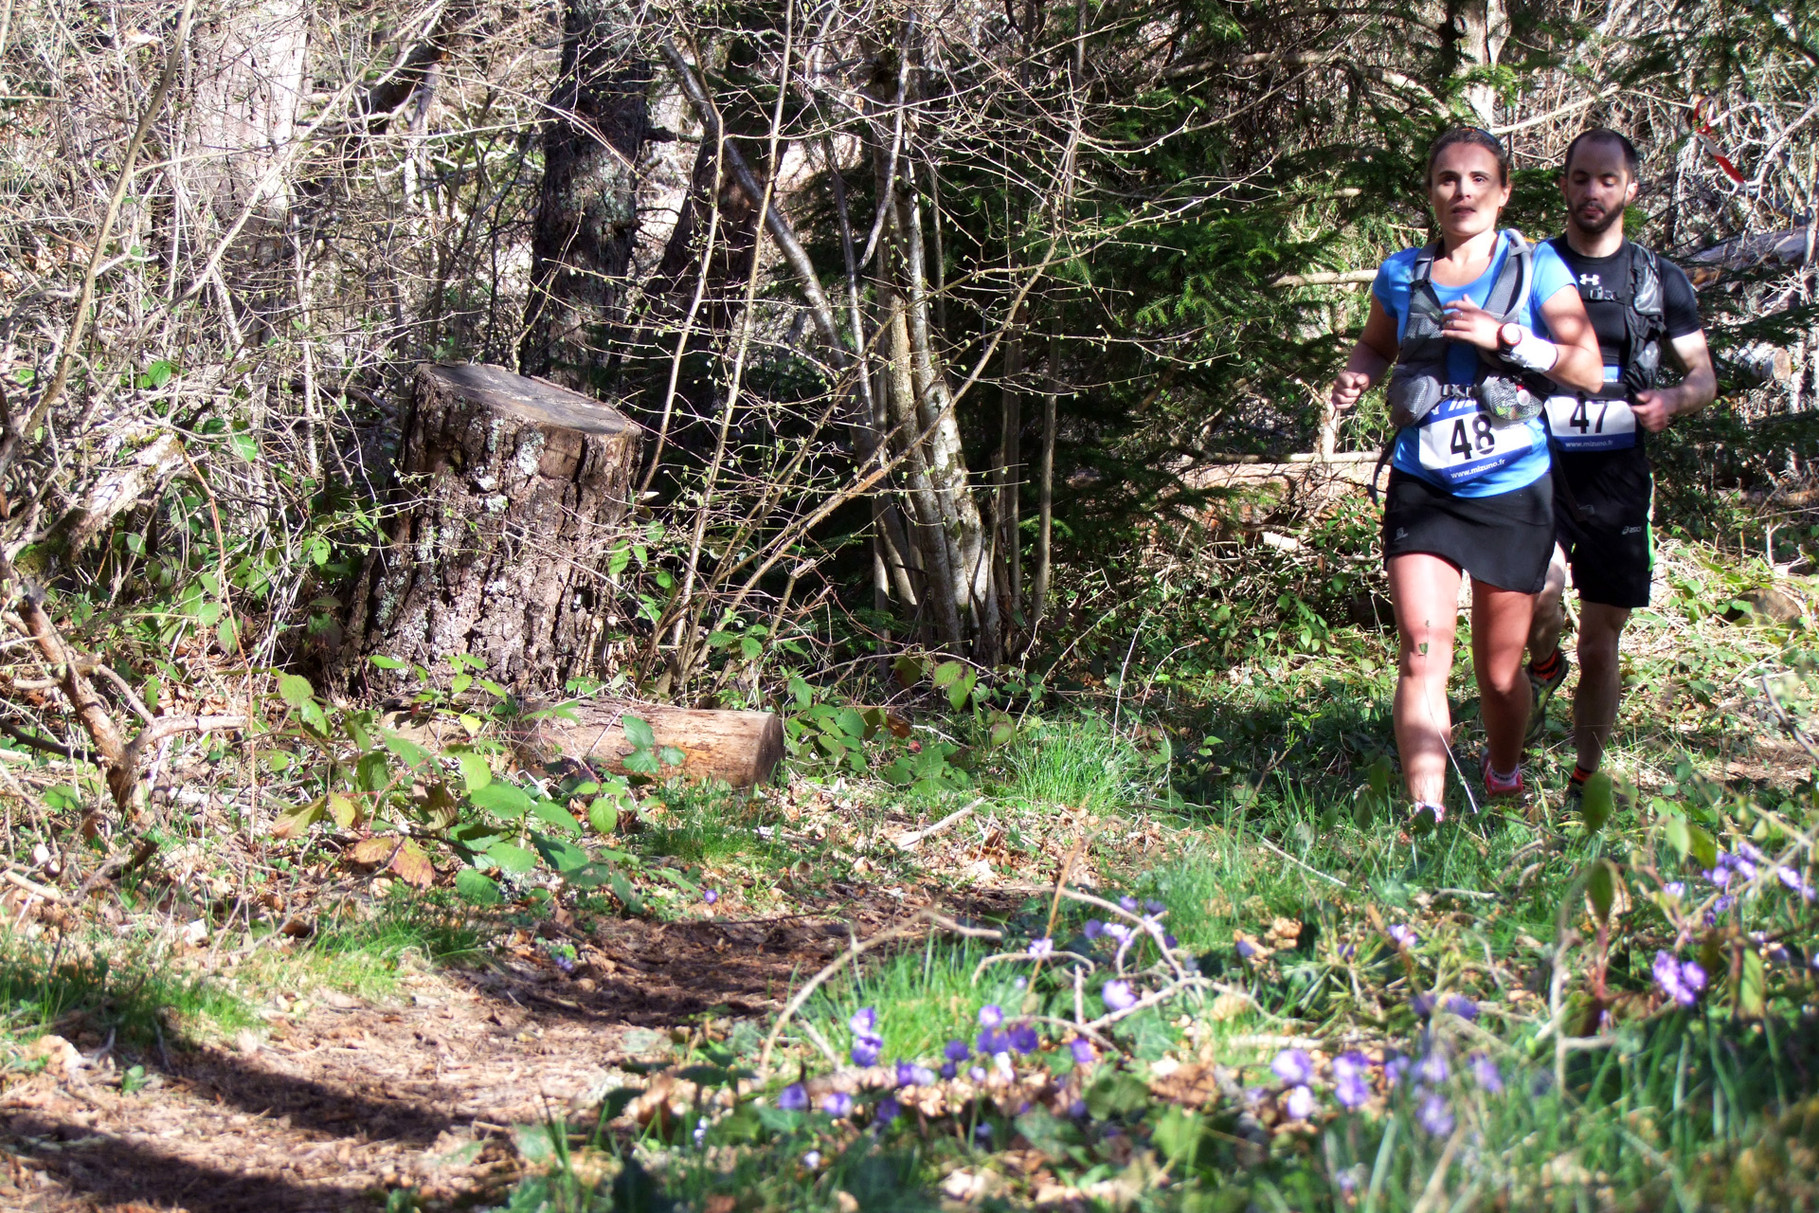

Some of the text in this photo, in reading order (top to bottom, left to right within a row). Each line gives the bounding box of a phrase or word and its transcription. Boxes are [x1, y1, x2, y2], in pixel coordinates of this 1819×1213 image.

[1570, 399, 1609, 434] 47
[1450, 415, 1495, 460] 48
[1565, 440, 1613, 449] www.mizuno.fr
[1451, 459, 1506, 479] www.mizuno.fr
